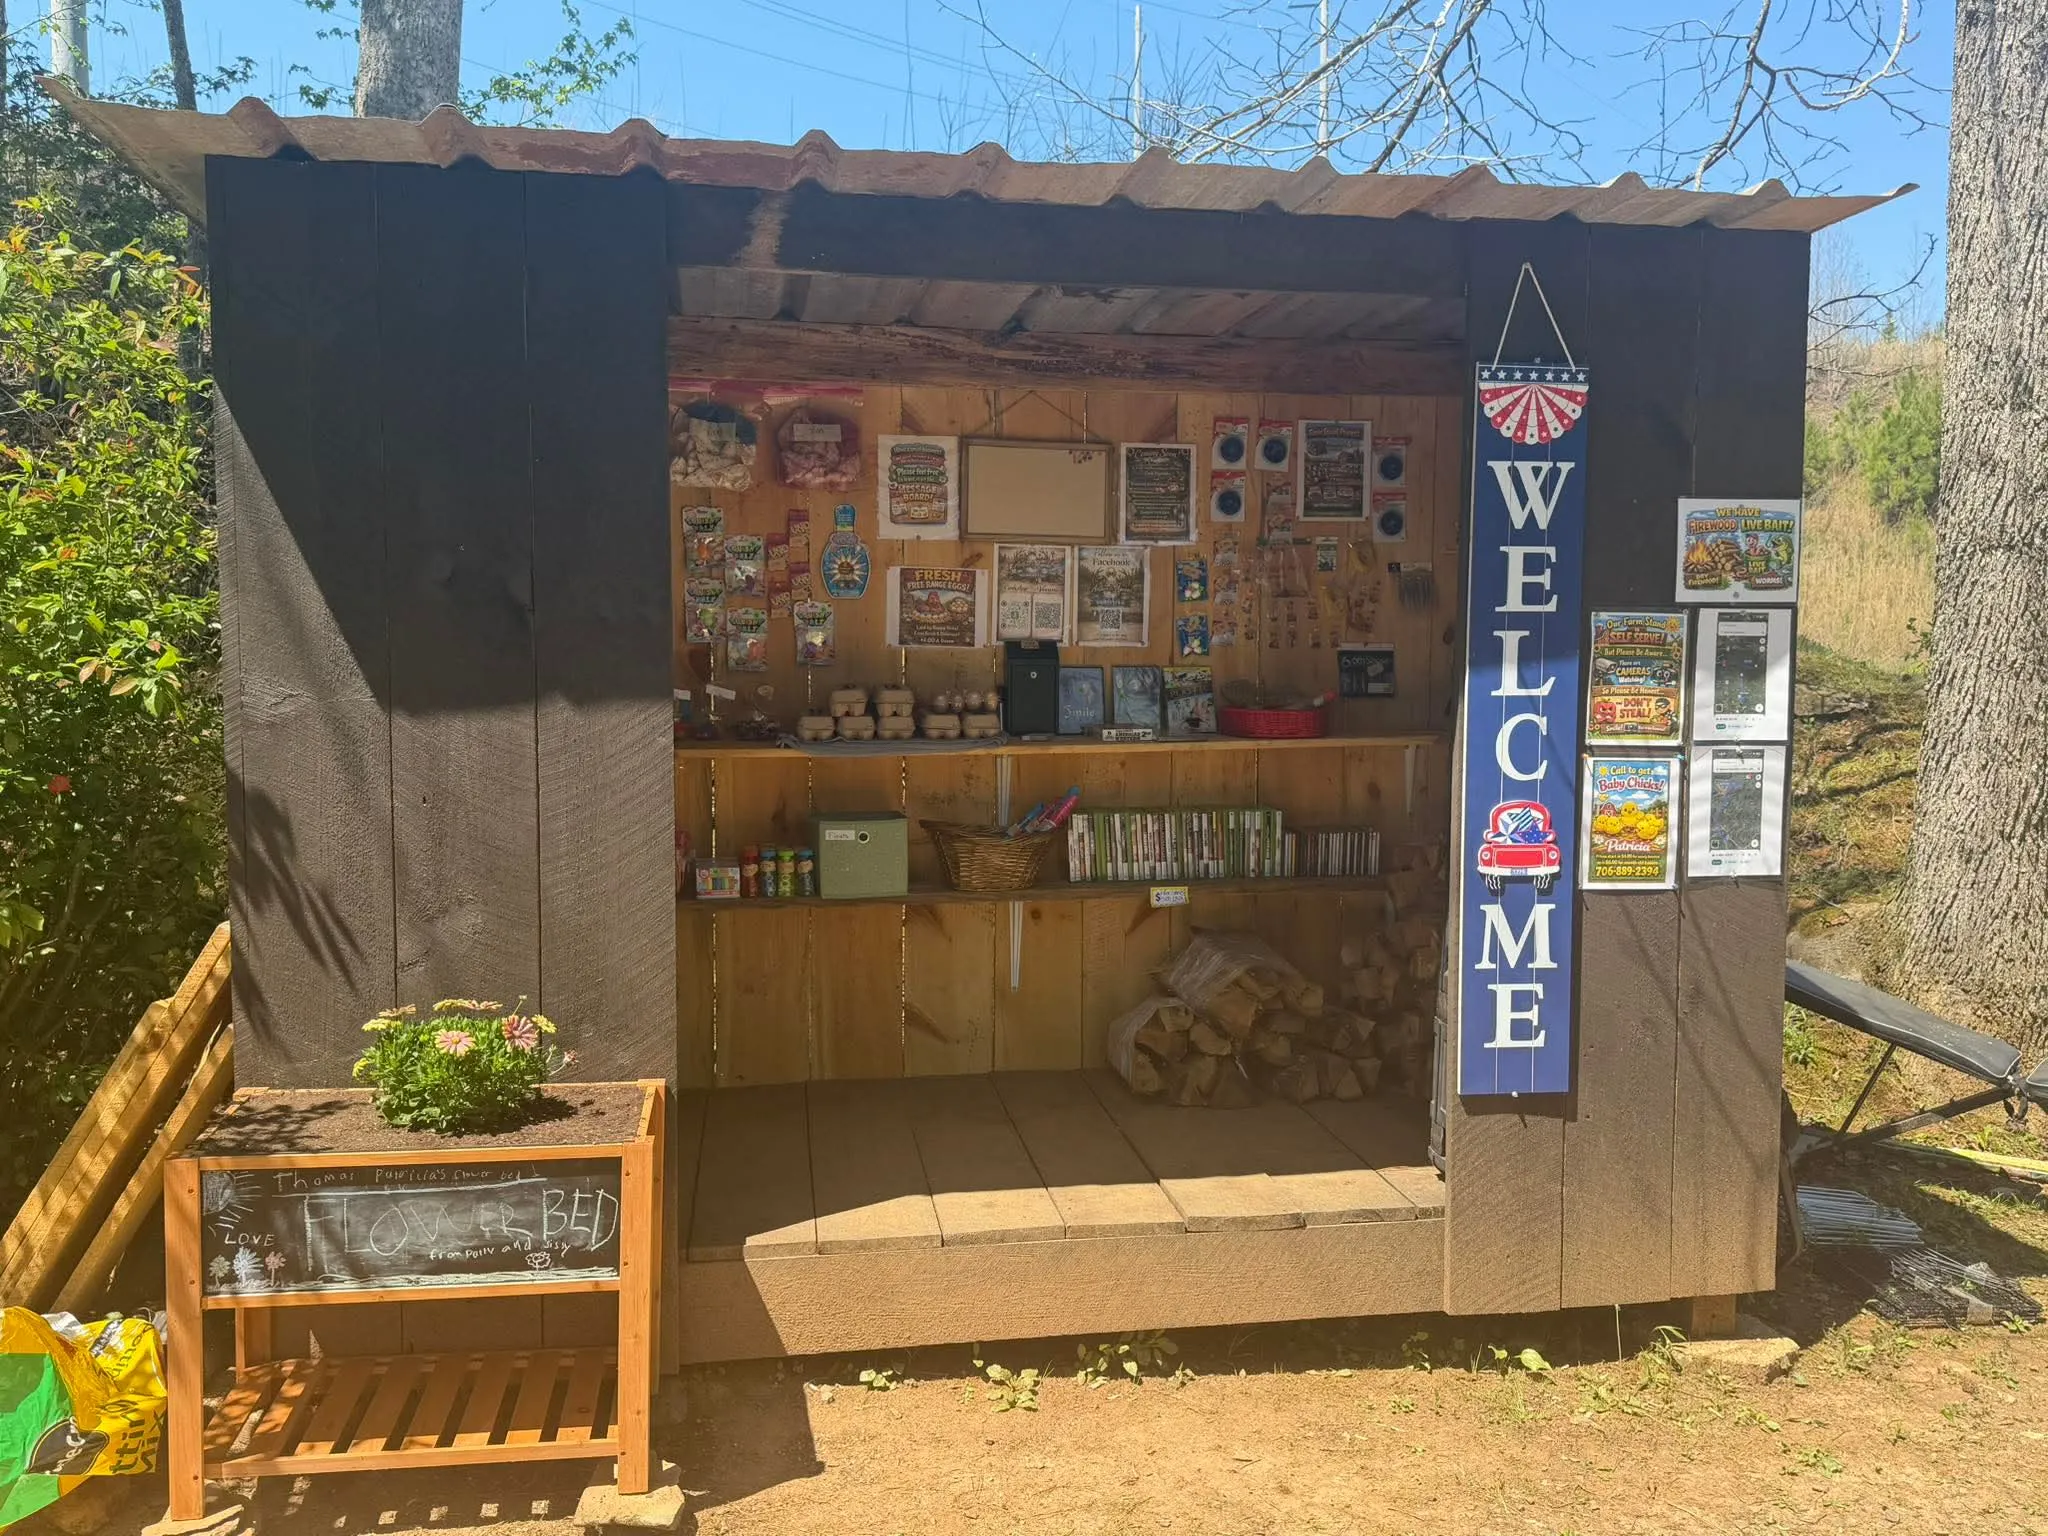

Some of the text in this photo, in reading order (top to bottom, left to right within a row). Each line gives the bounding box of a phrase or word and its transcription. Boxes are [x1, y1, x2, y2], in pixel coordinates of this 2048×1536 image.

[899, 484, 938, 494] MESSAGE
[903, 493, 934, 501] BOARD!
[1716, 507, 1761, 517] WE HAVE
[1687, 519, 1795, 534] FIREWOOD LIVE BAIT!
[1092, 558, 1131, 567] Facebook
[914, 570, 962, 581] FRESH
[1755, 577, 1783, 585] WORMS!
[907, 581, 970, 592] FREE RANGE EGGS!
[1607, 617, 1666, 629] Our Farm Stand
[1609, 631, 1665, 644] SELF SERVE!
[1604, 648, 1615, 656] But
[1616, 647, 1635, 656] Please
[1636, 648, 1643, 656] Be
[1615, 667, 1651, 676] CAMERAS
[1618, 675, 1646, 684] Watching!
[1602, 687, 1609, 695] So
[1610, 687, 1629, 695] Please
[1623, 698, 1653, 707] DON'T
[1619, 708, 1652, 719] STEAL!
[1606, 724, 1624, 732] Smile!
[1475, 460, 1576, 1049] WELCME
[1610, 765, 1626, 776] Call
[1628, 766, 1636, 776] to
[1598, 776, 1665, 792] Baby Chicks!
[1604, 839, 1651, 852] Patricia
[1595, 866, 1659, 877] 706-889-2394
[273, 1169, 353, 1193] Thomas
[543, 1188, 619, 1251] BED
[224, 1231, 276, 1247] LOVE
[429, 1248, 461, 1262] from
[501, 1236, 531, 1254] and
